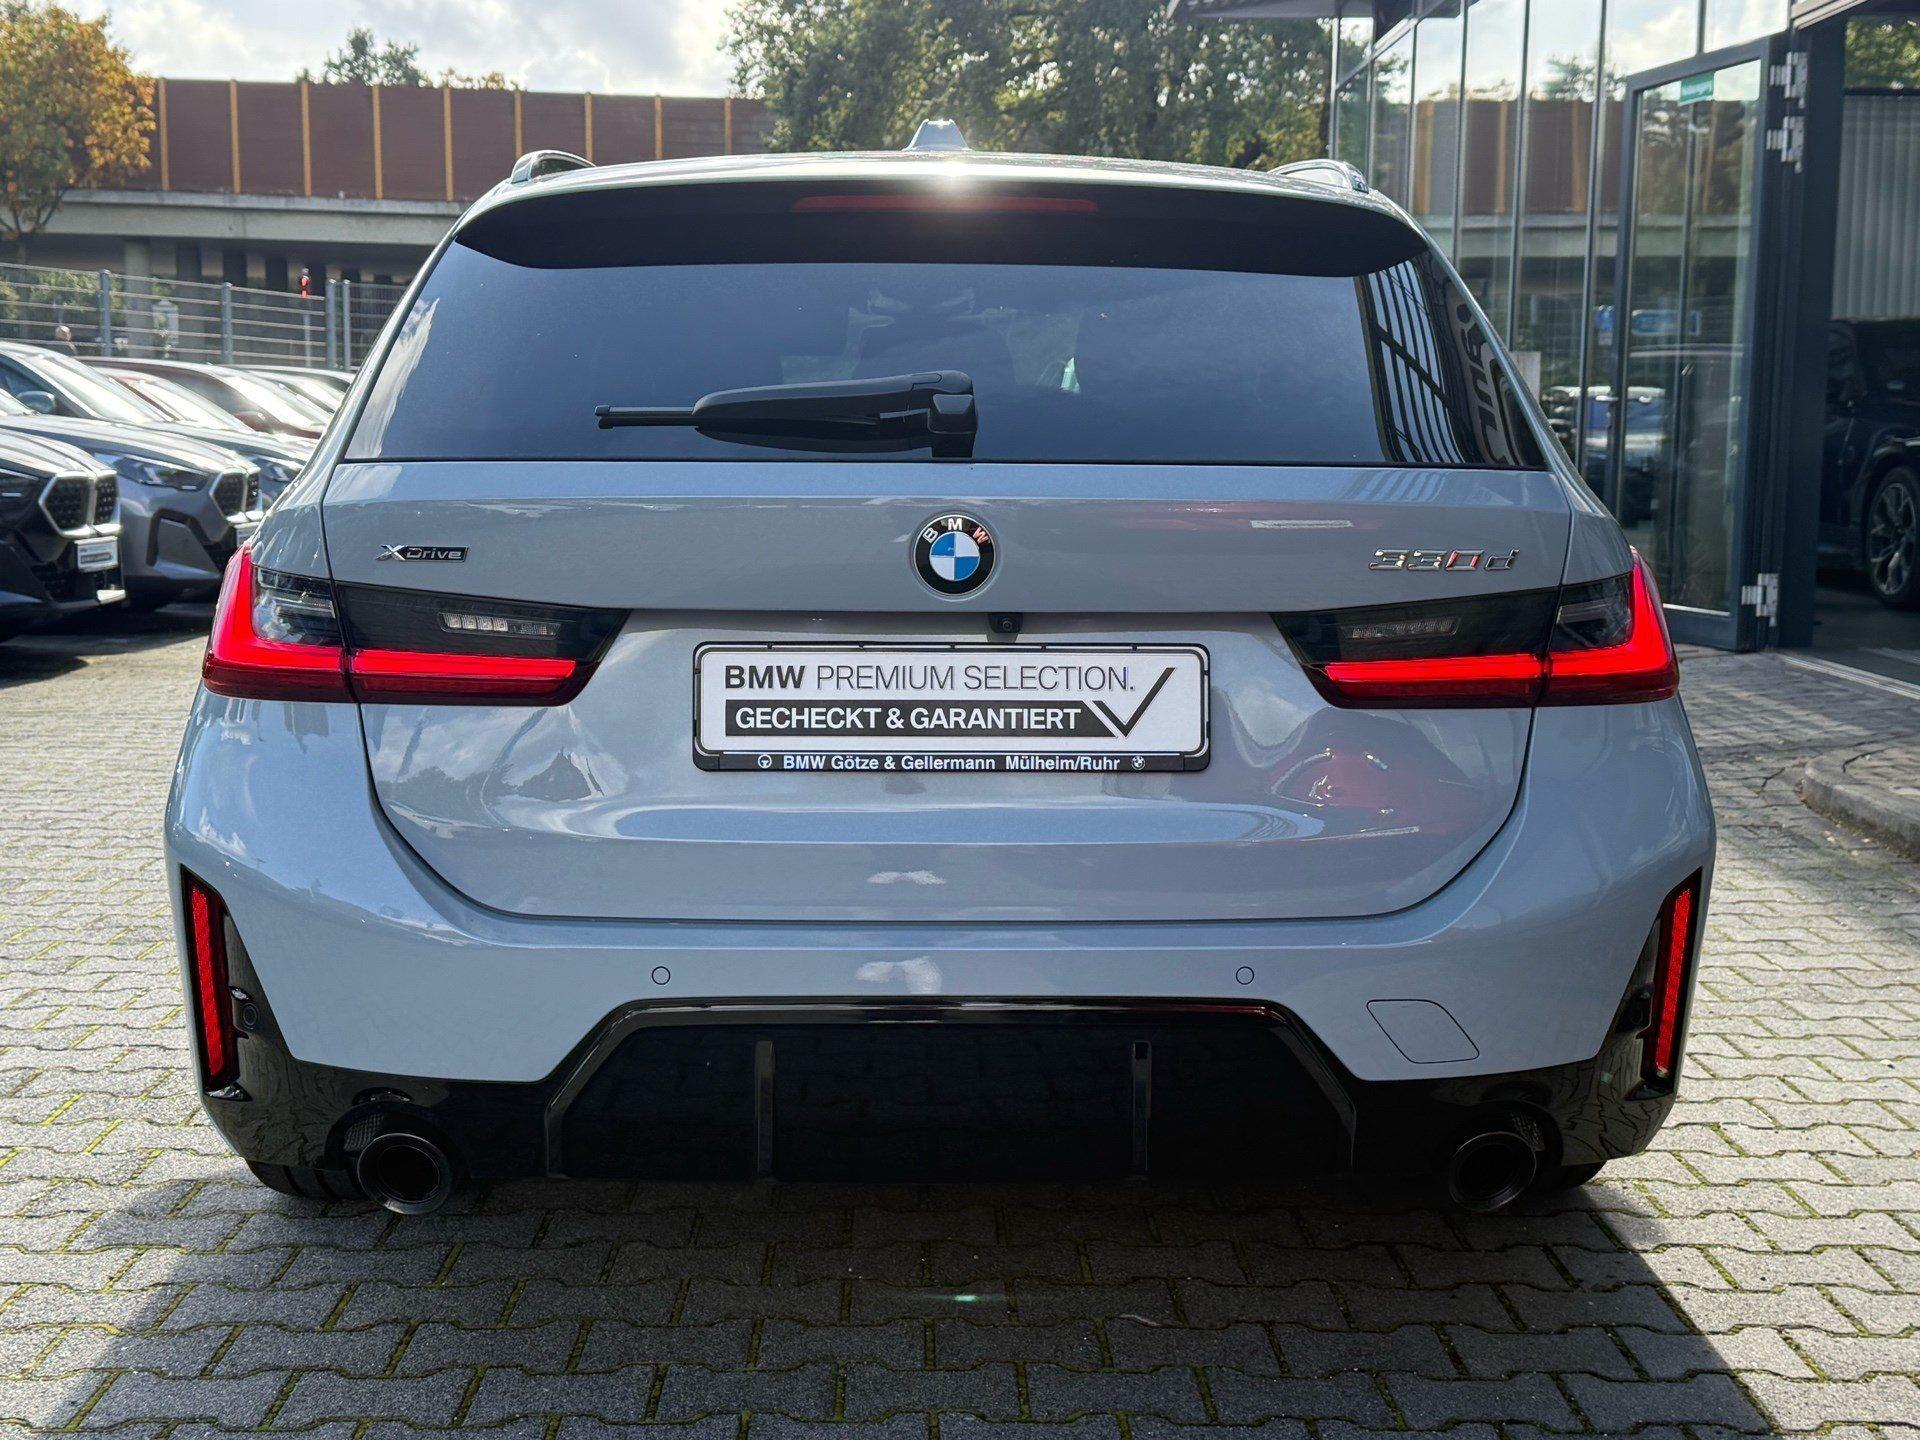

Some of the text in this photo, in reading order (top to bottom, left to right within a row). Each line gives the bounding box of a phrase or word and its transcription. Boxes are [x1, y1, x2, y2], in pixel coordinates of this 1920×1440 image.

[923, 518, 989, 544] BMW
[1369, 549, 1520, 571] 330d
[725, 665, 1134, 691] BMW PREMIUM SELECTION.
[735, 707, 1081, 730] GECHECKT & GARANTIERT
[783, 755, 1121, 771] BMW Götze & Gellermann Mülheim/Ruhr
